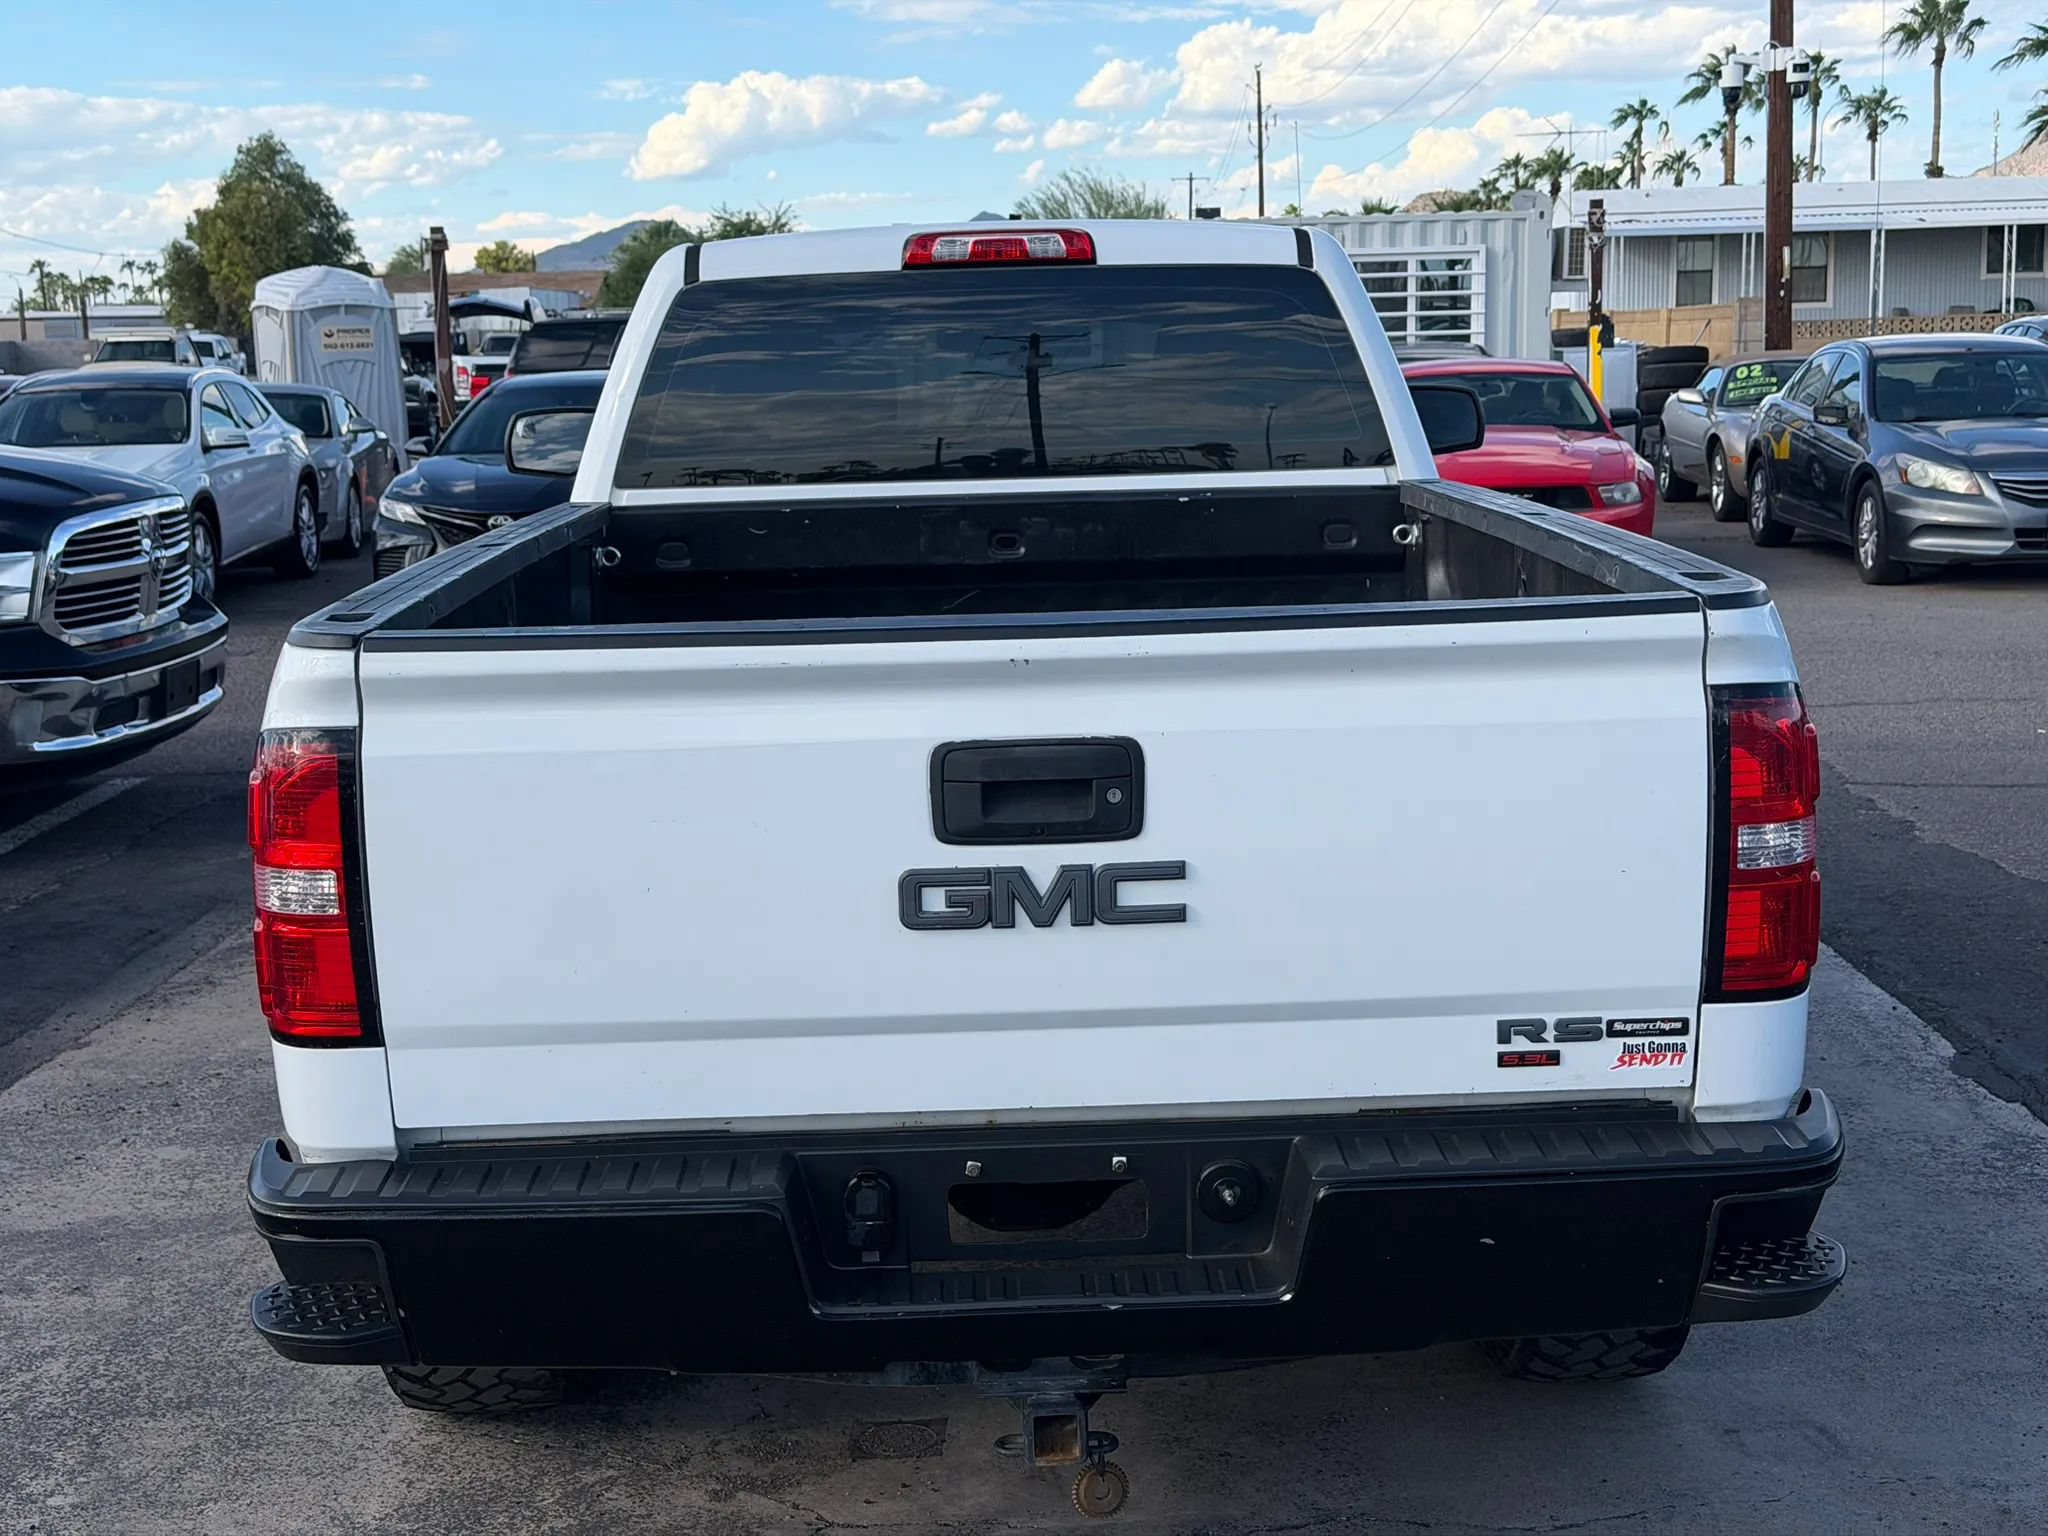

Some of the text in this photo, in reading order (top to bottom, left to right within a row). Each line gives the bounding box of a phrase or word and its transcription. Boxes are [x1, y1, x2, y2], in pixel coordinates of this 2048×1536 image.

[1736, 364, 1762, 379] 02
[898, 860, 1187, 930] GMC
[1497, 1016, 1604, 1044] RS
[1612, 1020, 1683, 1032] Superchips
[1622, 1040, 1687, 1055] Just Gonna
[1501, 1054, 1558, 1066] 5.3L
[1610, 1053, 1668, 1070] SEND
